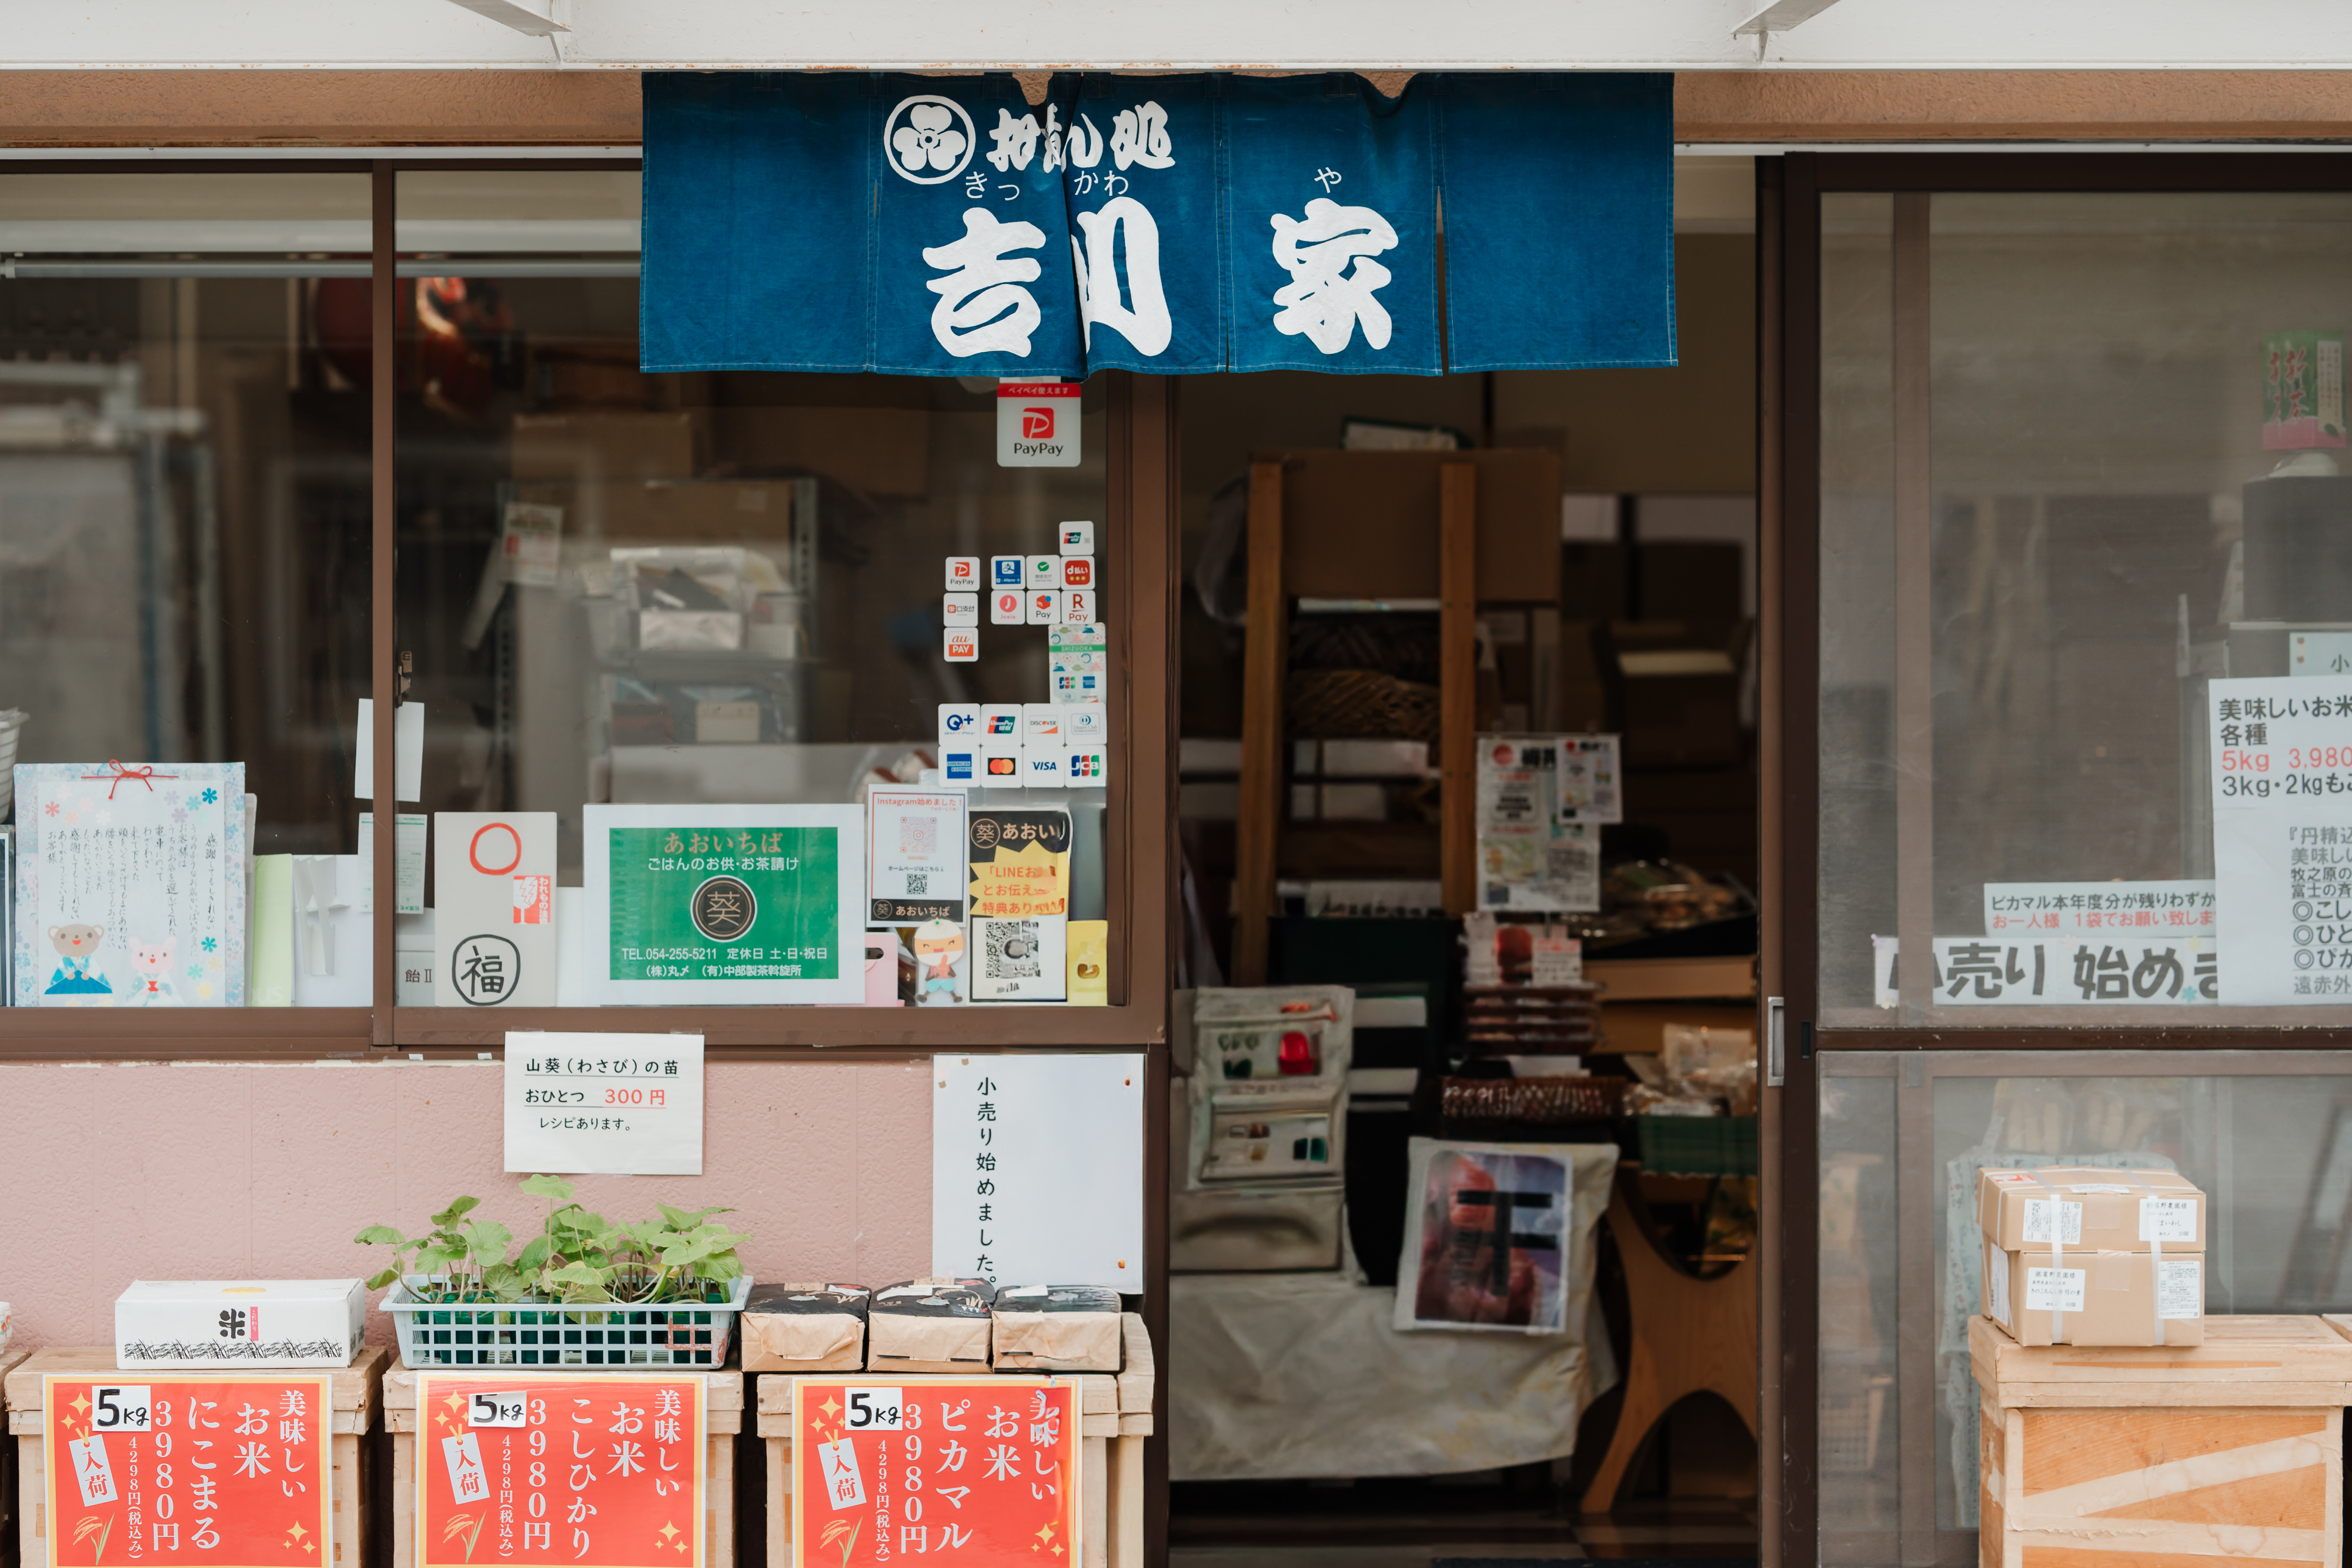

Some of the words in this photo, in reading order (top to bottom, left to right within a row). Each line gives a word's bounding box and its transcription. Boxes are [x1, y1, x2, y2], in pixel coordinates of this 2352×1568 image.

[1014, 442, 1064, 457] PayPay
[1067, 565, 1088, 574] d払い
[1036, 611, 1051, 619] Pay
[1073, 594, 1084, 609] R
[1069, 613, 1088, 622] Pay
[953, 645, 970, 653] PAY
[2219, 695, 2352, 721] 美味しいお米
[2220, 723, 2268, 747] 各種
[1031, 762, 1057, 770] VISA
[2222, 750, 2270, 773] 5kg
[2223, 773, 2352, 798] 3kg・2kgも
[664, 832, 784, 854] あおいちば
[648, 857, 800, 871] ごはんのお供・お茶請け
[706, 891, 741, 926] 葵
[896, 905, 950, 917] あおいちば
[1993, 912, 2060, 929] お一人様
[2074, 910, 2216, 929] 1袋でお願い致しま
[622, 948, 717, 961] TEL.054-255-5211
[727, 948, 763, 960] 定休日
[460, 945, 505, 997] 福
[526, 1058, 679, 1075] 山葵（わさび）の苗
[526, 1089, 585, 1103] おひとつ
[605, 1089, 643, 1104] 300
[650, 1089, 665, 1105] 円
[540, 1117, 630, 1131] レシピあります。
[976, 1077, 997, 1283] 小売り始めました。
[219, 1308, 246, 1339] 米
[97, 1388, 150, 1427] 5kg
[473, 1394, 525, 1424] 5kg
[850, 1393, 902, 1427] 5kg
[233, 1402, 272, 1479] お米
[279, 1389, 307, 1498] 美味しい
[606, 1402, 646, 1477] お米
[654, 1389, 682, 1497] 美味しい
[982, 1405, 1021, 1482] お米
[82, 1451, 108, 1498] 入荷
[153, 1400, 180, 1551] 3980円
[188, 1396, 220, 1550] にこまる
[455, 1449, 480, 1496] 入荷
[523, 1398, 552, 1550] 3980円
[567, 1398, 597, 1559] こしひかり
[831, 1454, 857, 1502] 入荷
[902, 1403, 928, 1554] 3980円
[934, 1399, 974, 1552] ピカマル
